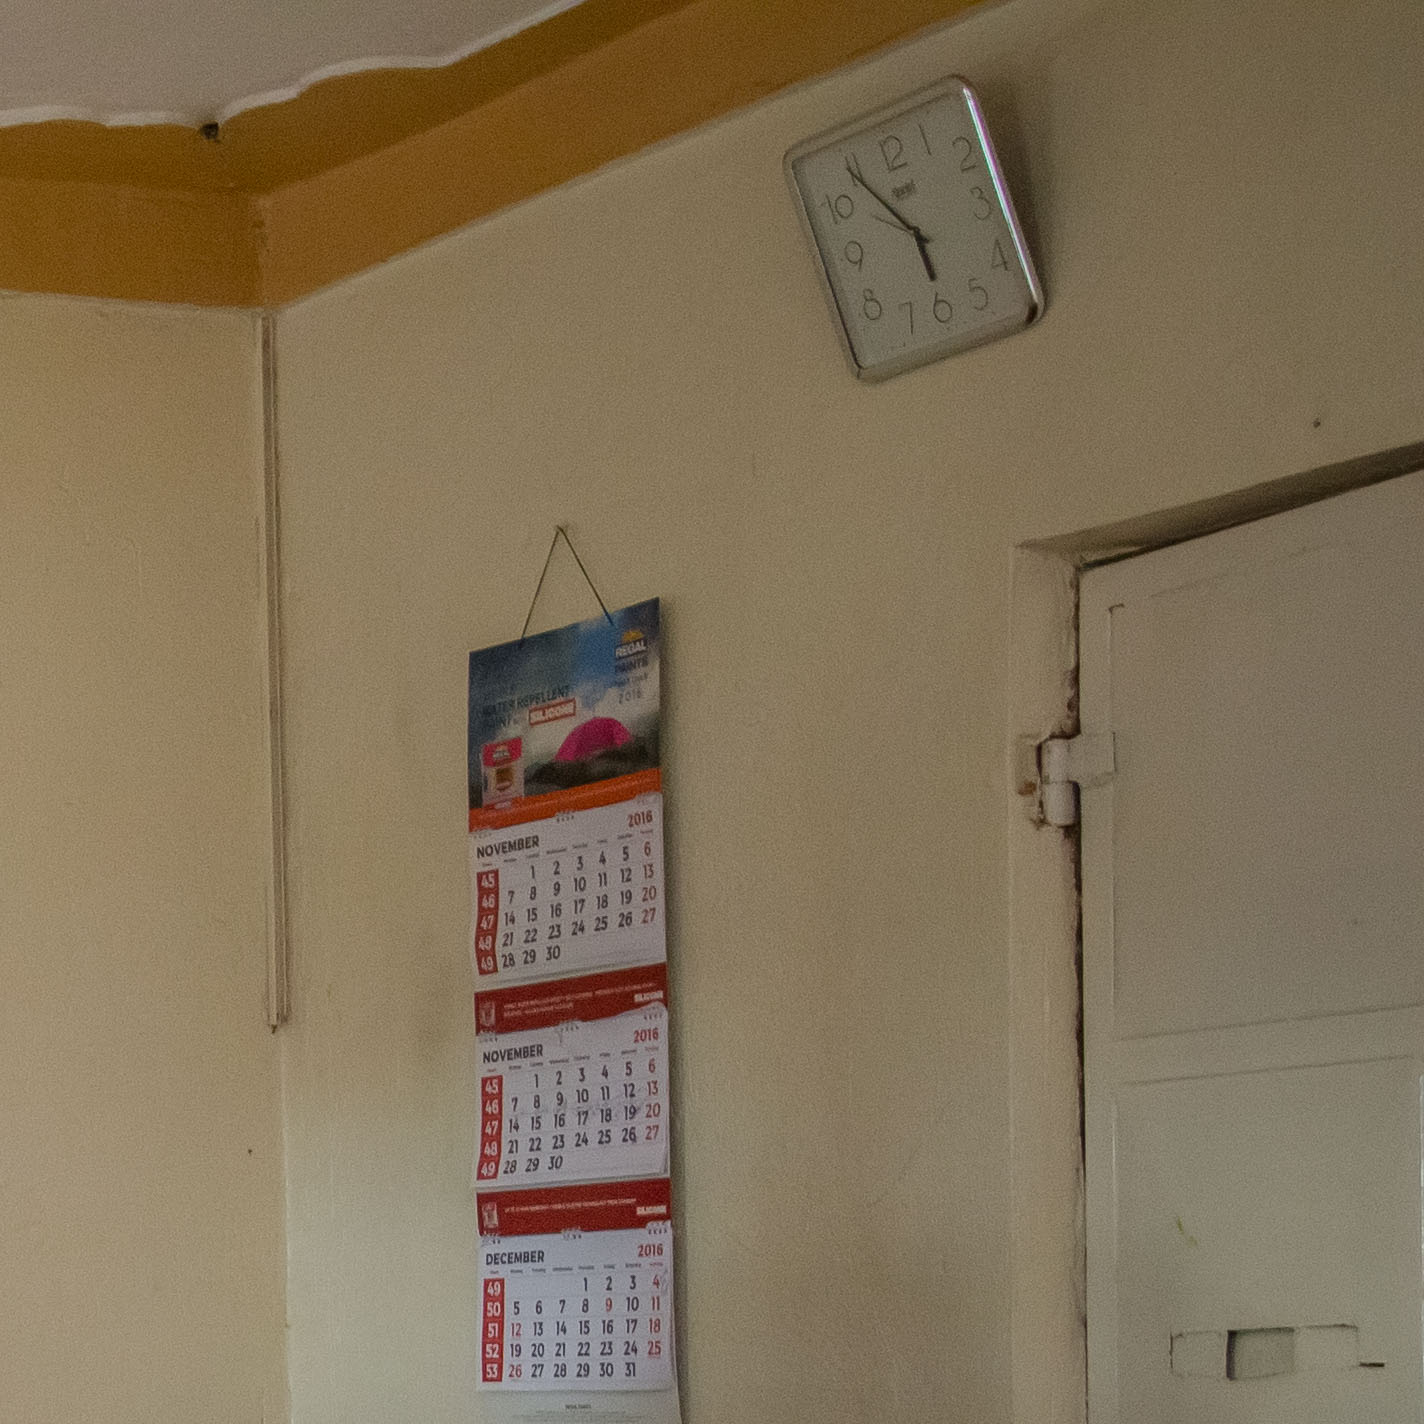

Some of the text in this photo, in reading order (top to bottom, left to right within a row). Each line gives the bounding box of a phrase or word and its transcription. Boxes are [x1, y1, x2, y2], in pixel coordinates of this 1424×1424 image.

[879, 135, 908, 171] 12
[919, 124, 931, 156] 1
[952, 137, 977, 172] 2
[821, 194, 854, 224] 10
[971, 187, 993, 221] 3
[844, 241, 863, 271] 9
[991, 239, 1009, 271] 4
[863, 289, 882, 320] 8
[932, 292, 953, 323] 6
[968, 278, 989, 310] 5
[899, 301, 915, 334] 7
[629, 810, 653, 827] 2016
[477, 835, 539, 859] NOVEMBER
[531, 865, 535, 879] 1
[554, 861, 560, 875] 2
[577, 856, 583, 870] 3
[599, 852, 606, 865] 4
[623, 846, 629, 861] 5
[644, 841, 651, 856] 6
[508, 890, 515, 903] 7
[530, 886, 536, 900] 8
[554, 882, 560, 896] 9
[574, 877, 586, 892] 10
[598, 872, 607, 887] 11
[620, 867, 632, 883] 12
[643, 863, 654, 879] 13
[505, 912, 515, 926] 14
[527, 907, 537, 922] 15
[550, 903, 562, 918] 16
[574, 898, 586, 914] 17
[597, 894, 608, 909] 18
[621, 890, 632, 905] 19
[642, 886, 657, 902] 20
[502, 932, 513, 947] 21
[524, 928, 537, 943] 22
[548, 924, 561, 940] 23
[572, 921, 585, 936] 24
[595, 916, 608, 931] 25
[618, 912, 632, 927] 26
[642, 907, 656, 924] 27
[502, 953, 515, 968] 28
[523, 949, 536, 964] 29
[546, 945, 560, 961] 30
[634, 1028, 659, 1043] 2016
[483, 1044, 543, 1063] NOVEMBER
[534, 1074, 539, 1088] 1
[556, 1071, 562, 1085] 2
[579, 1067, 585, 1082] 3
[602, 1065, 608, 1078] 4
[626, 1061, 632, 1076] 5
[649, 1059, 656, 1073] 6
[512, 1097, 518, 1111] 7
[534, 1095, 540, 1109] 8
[557, 1092, 563, 1106] 9
[576, 1089, 589, 1103] 10
[601, 1086, 610, 1100] 11
[624, 1083, 635, 1098] 12
[647, 1080, 658, 1096] 13
[509, 1119, 519, 1132] 14
[531, 1115, 541, 1130] 15
[554, 1113, 565, 1128] 16
[577, 1110, 589, 1125] 17
[600, 1108, 612, 1123] 18
[624, 1105, 638, 1120] 19
[646, 1103, 660, 1118] 20
[508, 1139, 518, 1154] 21
[529, 1137, 541, 1152] 22
[553, 1134, 565, 1149] 23
[575, 1133, 588, 1147] 24
[598, 1129, 611, 1145] 25
[622, 1127, 636, 1143] 26
[645, 1125, 659, 1140] 27
[503, 1160, 517, 1174] 28
[525, 1158, 539, 1172] 29
[548, 1155, 563, 1170] 30
[486, 1250, 544, 1265] DECEMBER
[638, 1244, 663, 1257] 2016
[584, 1277, 588, 1291] 1
[606, 1276, 612, 1291] 2
[630, 1275, 636, 1290] 3
[653, 1275, 660, 1288] 4
[514, 1301, 520, 1315] 5
[536, 1300, 542, 1314] 6
[559, 1299, 566, 1313] 7
[582, 1298, 589, 1313] 8
[606, 1298, 612, 1312] 9
[626, 1296, 639, 1311] 10
[652, 1296, 660, 1310] 11
[511, 1323, 521, 1337] 12
[533, 1322, 543, 1336] 13
[556, 1321, 567, 1335] 14
[579, 1320, 590, 1335] 15
[602, 1319, 613, 1334] 16
[626, 1319, 638, 1333] 17
[649, 1318, 661, 1333] 18
[510, 1343, 522, 1357] 19
[532, 1343, 544, 1357] 20
[555, 1342, 566, 1357] 21
[578, 1342, 590, 1356] 22
[600, 1341, 613, 1356] 23
[624, 1341, 638, 1355] 24
[648, 1341, 661, 1356] 25
[509, 1364, 522, 1378] 26
[531, 1364, 544, 1378] 27
[554, 1363, 566, 1377] 28
[576, 1363, 590, 1377] 29
[600, 1362, 613, 1377] 30
[625, 1362, 636, 1377] 31
